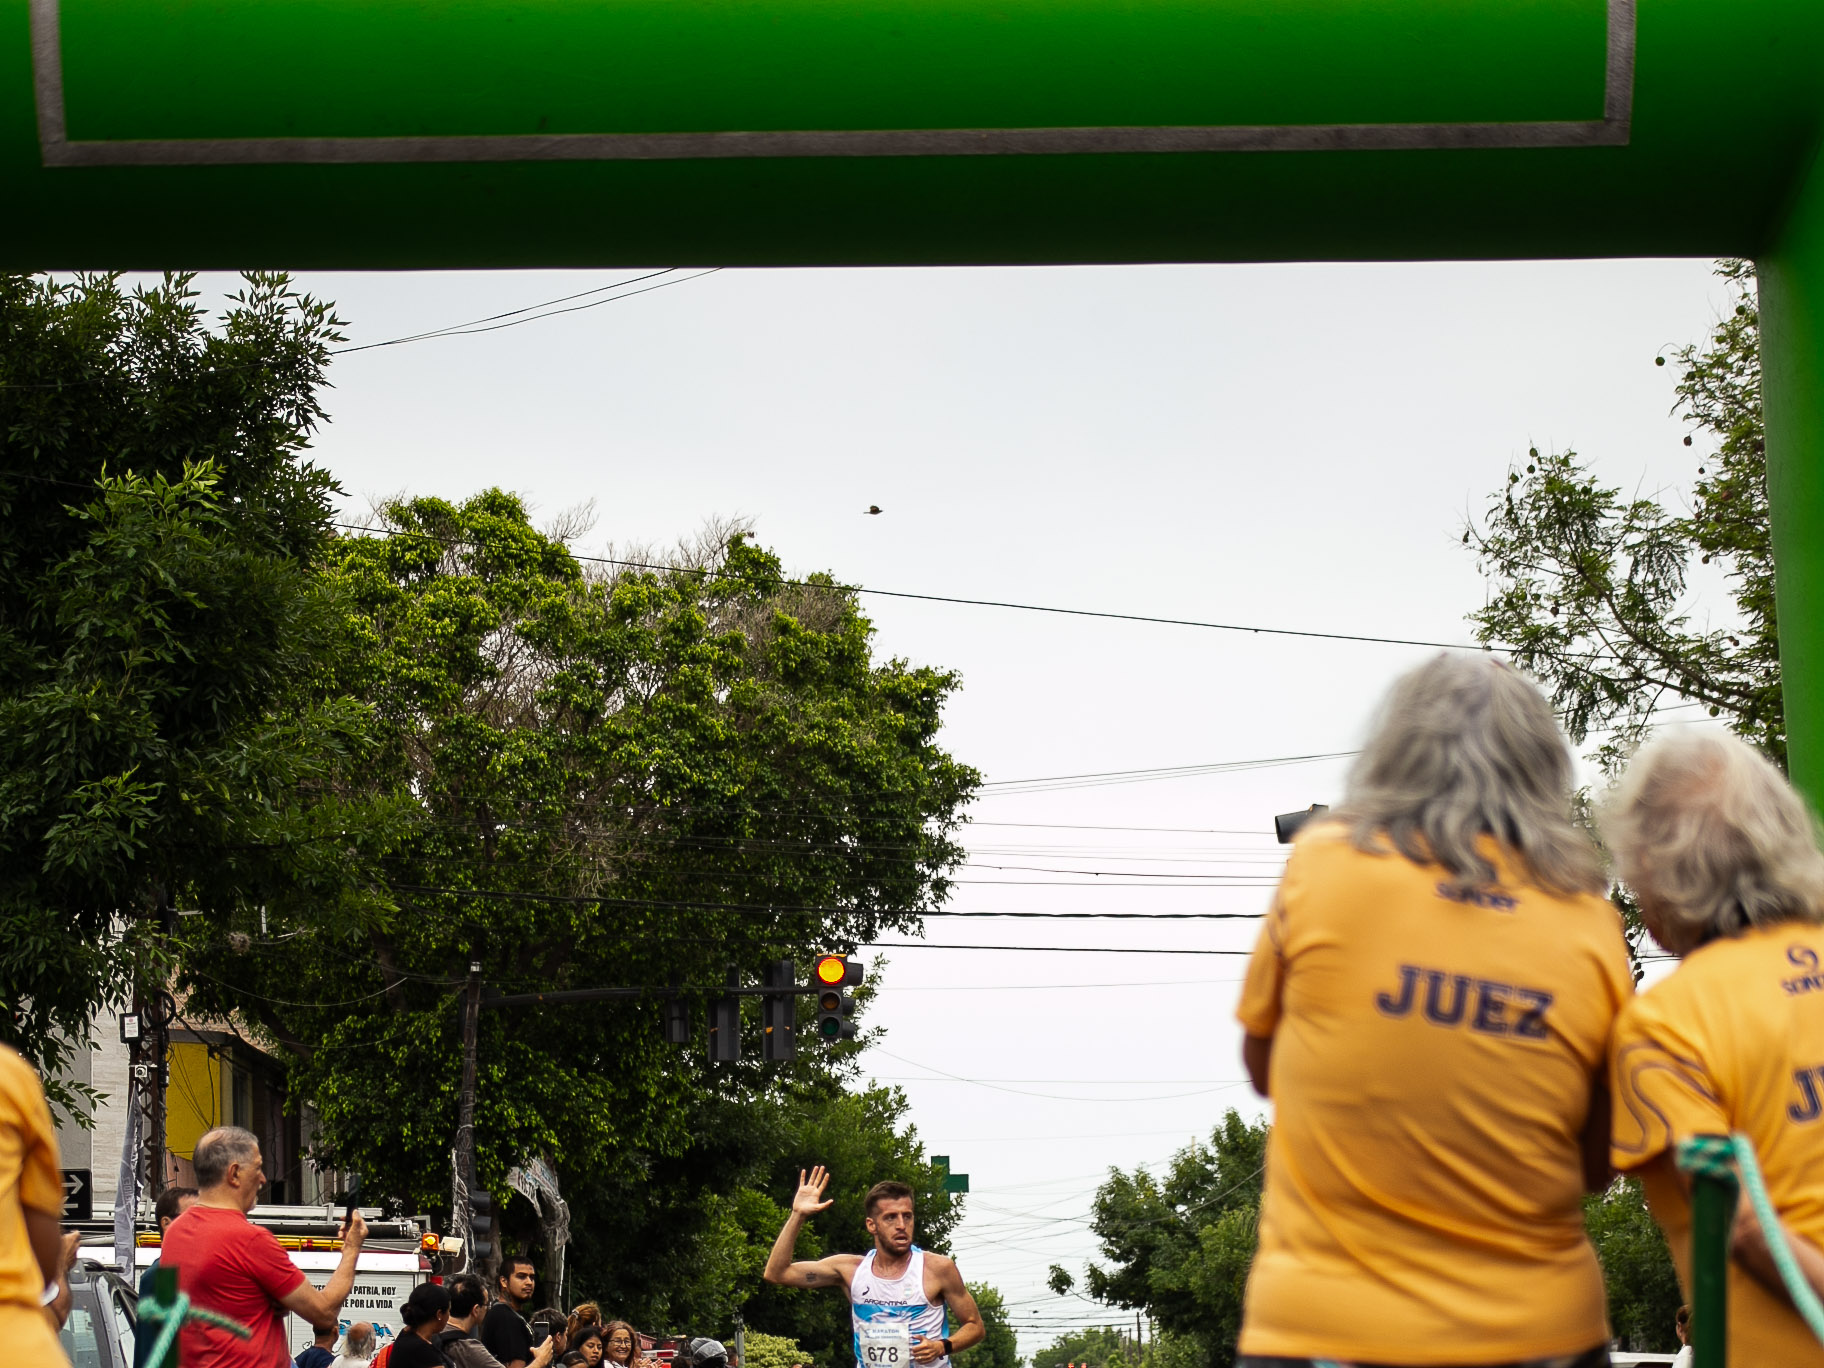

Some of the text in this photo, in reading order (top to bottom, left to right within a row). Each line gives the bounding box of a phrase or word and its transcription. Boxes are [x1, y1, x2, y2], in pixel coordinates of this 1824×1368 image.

[1374, 963, 1555, 1043] JUEZ
[353, 1285, 380, 1296] PATRIA,
[382, 1286, 396, 1295] HOY
[350, 1299, 364, 1308] POR
[366, 1300, 374, 1308] LA
[376, 1300, 393, 1309] VIDA
[864, 1298, 907, 1306] ARGENTINA
[867, 1346, 899, 1363] 678
